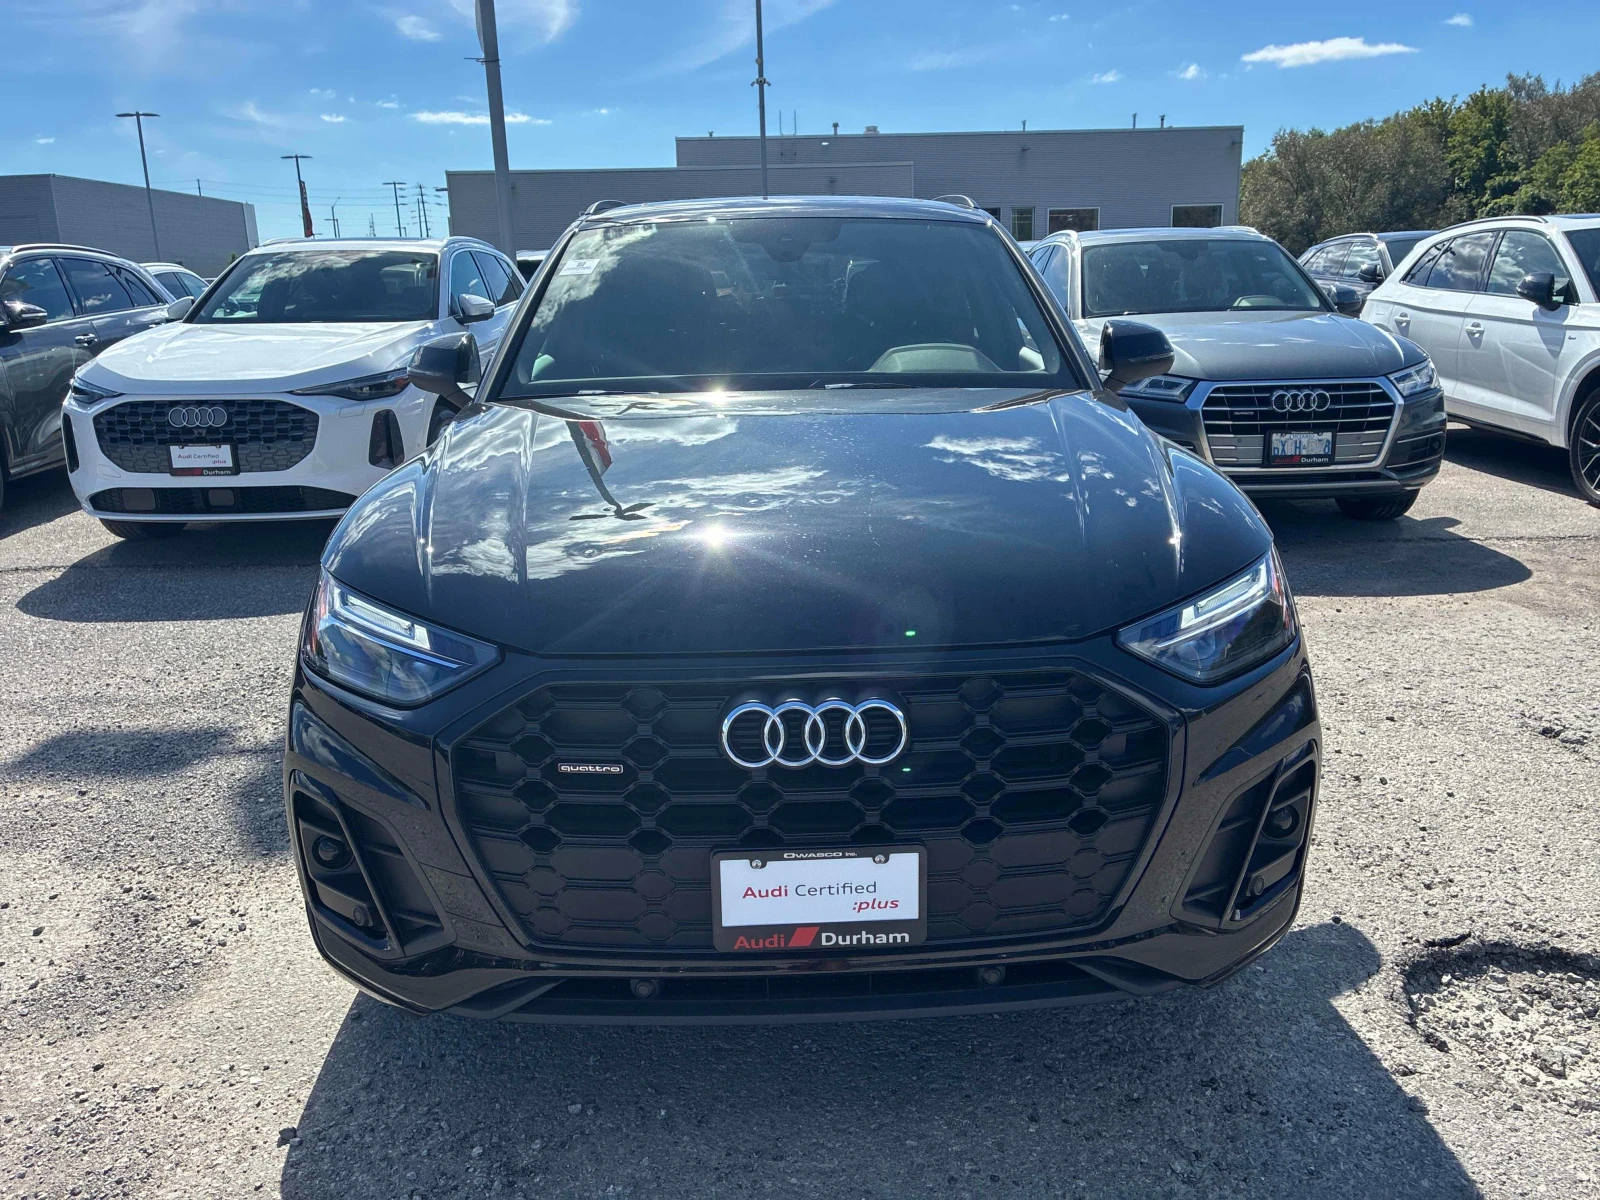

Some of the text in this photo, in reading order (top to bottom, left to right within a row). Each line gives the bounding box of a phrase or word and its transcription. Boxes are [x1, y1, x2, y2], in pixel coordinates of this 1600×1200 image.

[742, 882, 877, 899] Audi Certified
[852, 898, 899, 912] :plus
[734, 930, 910, 950] Audi Durham
